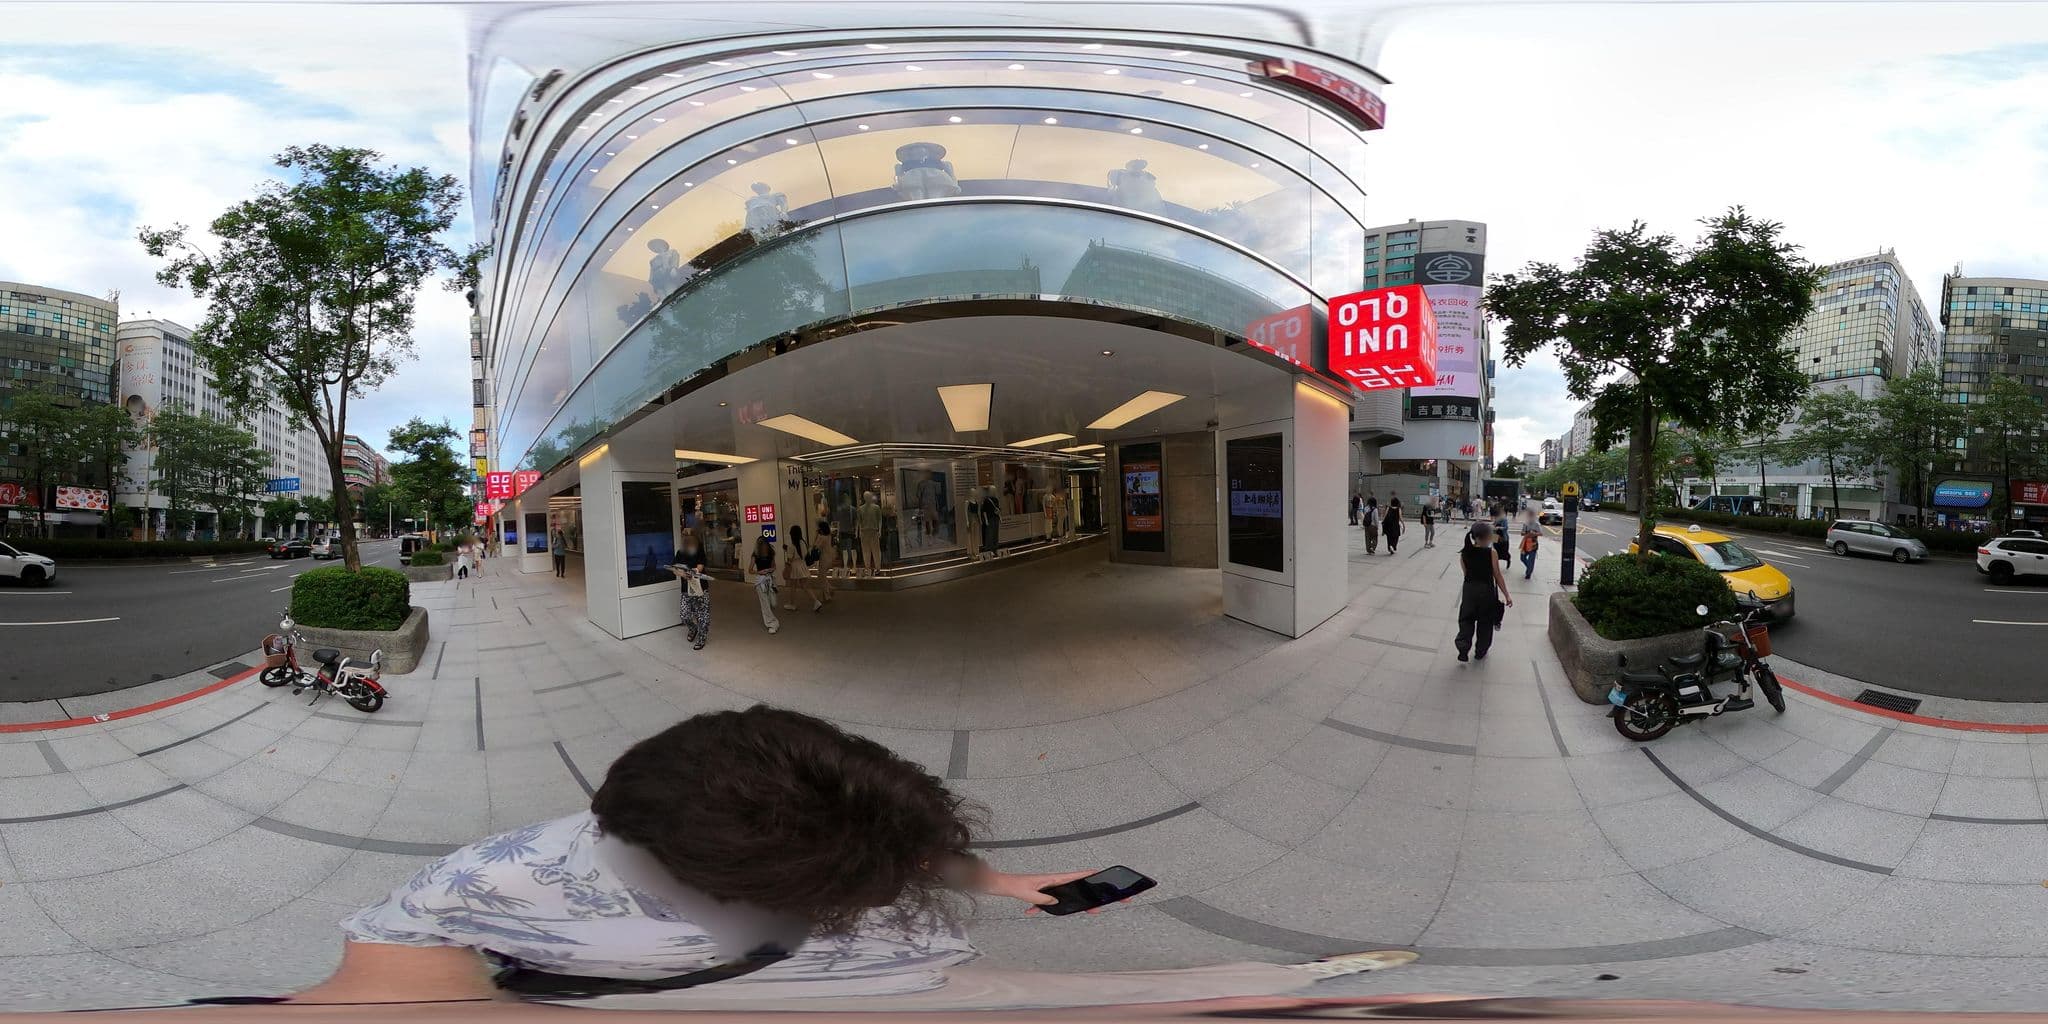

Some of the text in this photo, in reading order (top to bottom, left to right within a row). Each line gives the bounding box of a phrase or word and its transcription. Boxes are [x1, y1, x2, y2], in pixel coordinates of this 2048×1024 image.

[1338, 291, 1408, 326] QLO
[1344, 324, 1408, 356] UNI
[1418, 404, 1472, 417] 吉富投資
[787, 464, 803, 475] This
[788, 479, 800, 491] My
[803, 474, 823, 487] Best
[1232, 479, 1242, 488] B1
[761, 505, 772, 513] UNI
[762, 513, 774, 521] QLO
[763, 529, 776, 538] GU
